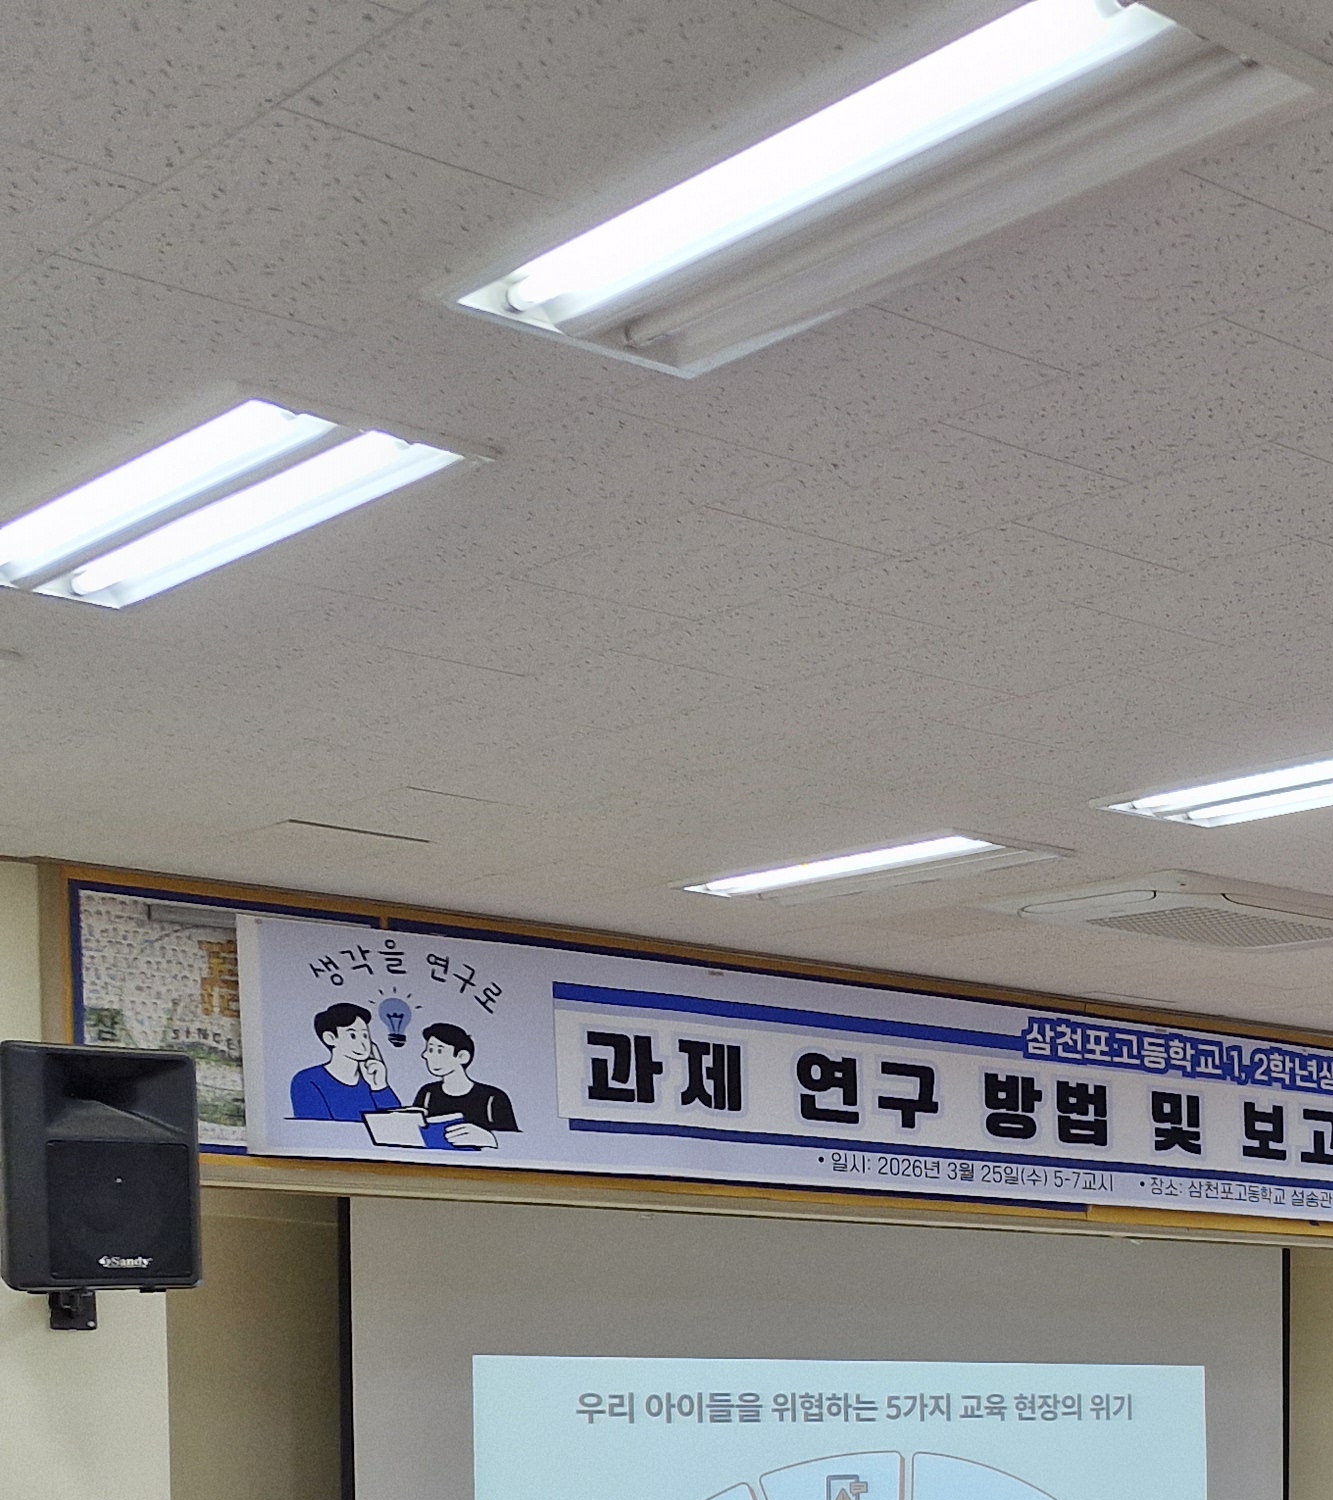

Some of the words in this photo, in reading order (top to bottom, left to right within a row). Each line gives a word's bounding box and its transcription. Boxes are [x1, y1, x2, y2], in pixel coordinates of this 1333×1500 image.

[310, 938, 406, 986] 생각을
[426, 953, 503, 1014] 연구로
[1026, 1020, 1223, 1076] 삼천포고등학교
[586, 1030, 742, 1112] 과제
[796, 1051, 939, 1129] 연구
[984, 1071, 1107, 1147] 방법
[1151, 1090, 1202, 1155] 및
[831, 1152, 872, 1174] 일시:
[878, 1156, 942, 1180] 2026년
[947, 1162, 975, 1182] 3월
[981, 1164, 1048, 1187] 25일(수)
[1054, 1170, 1114, 1192] 5-7교시
[1151, 1177, 1183, 1197] 장소:
[1188, 1180, 1286, 1205] 삼천포고등학교
[1291, 1190, 1333, 1208] 설송관
[576, 1392, 635, 1424] 우리
[645, 1392, 763, 1424] 아이들을
[771, 1392, 879, 1423] 위협하는
[885, 1393, 952, 1422] 5가지
[959, 1393, 1007, 1422] 교육
[1014, 1393, 1083, 1421] 현장의
[1089, 1393, 1133, 1421] 위기
